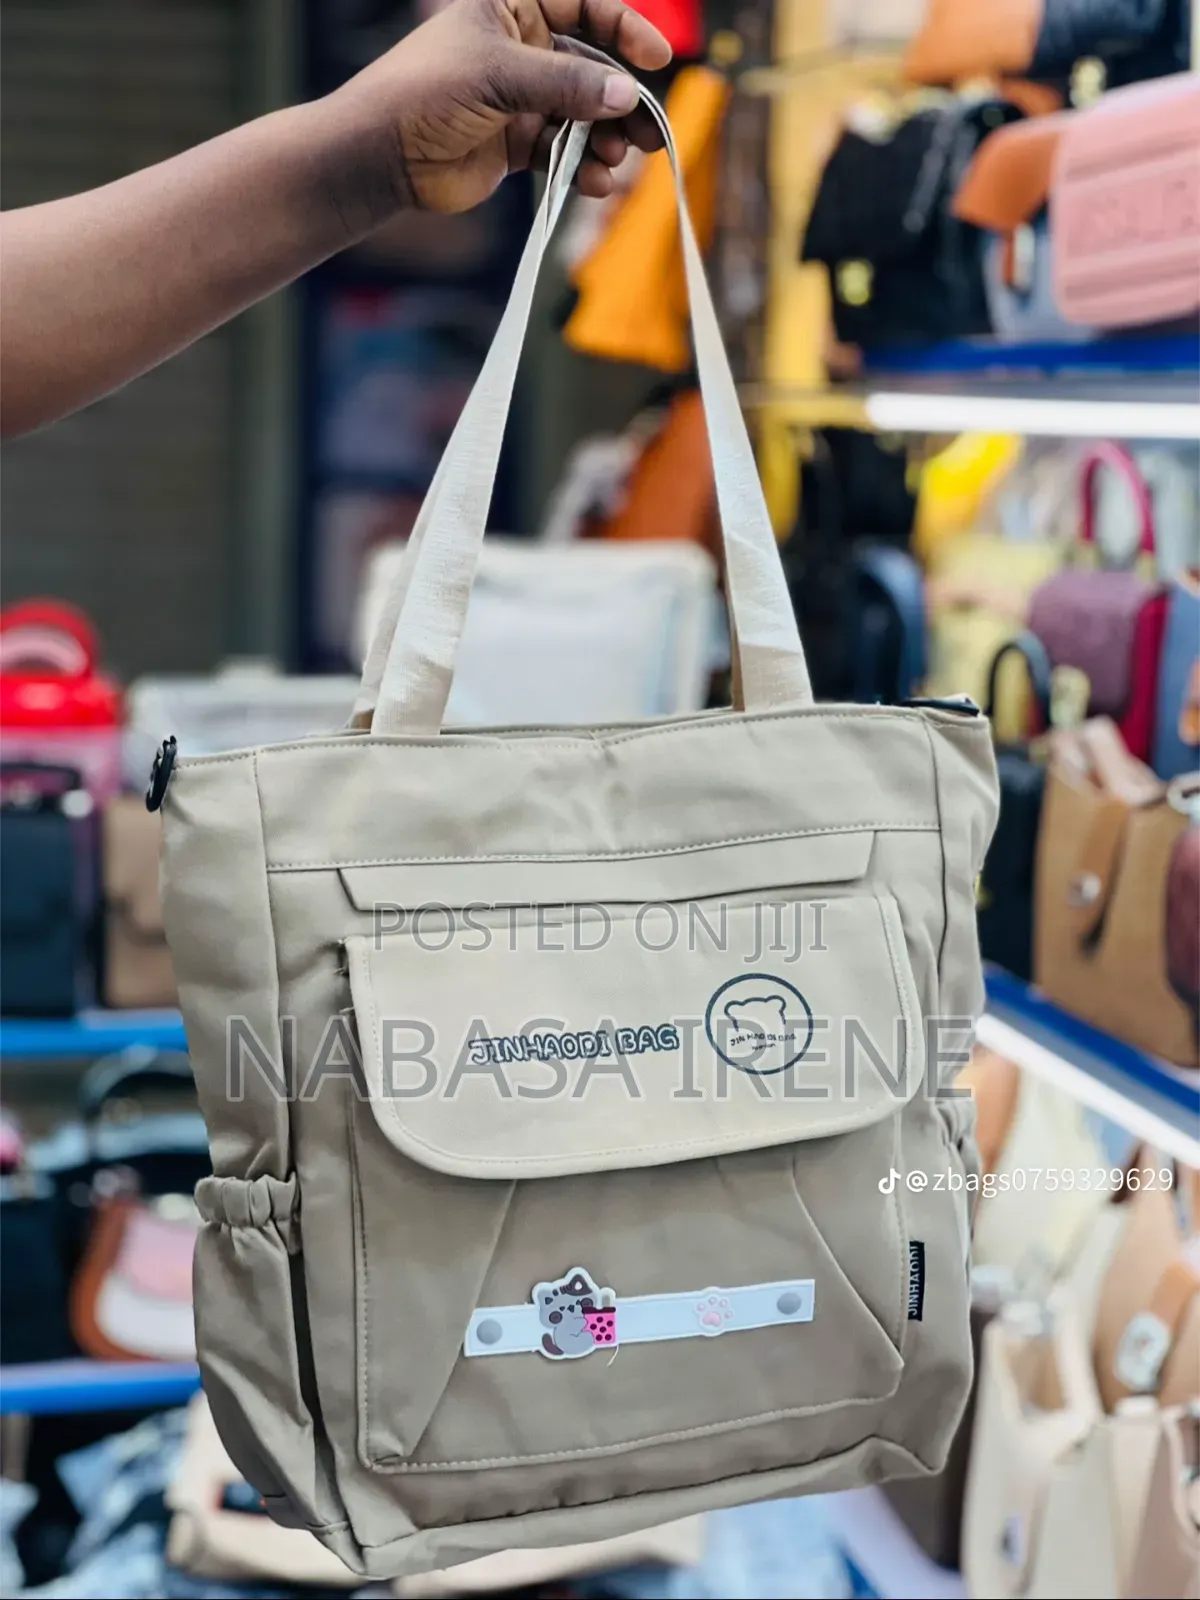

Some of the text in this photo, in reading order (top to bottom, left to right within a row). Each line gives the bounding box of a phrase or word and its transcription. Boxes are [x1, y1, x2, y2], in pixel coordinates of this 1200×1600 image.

[468, 1024, 680, 1065] JINHAODI BAG
[908, 1245, 920, 1316] JINHAODI
